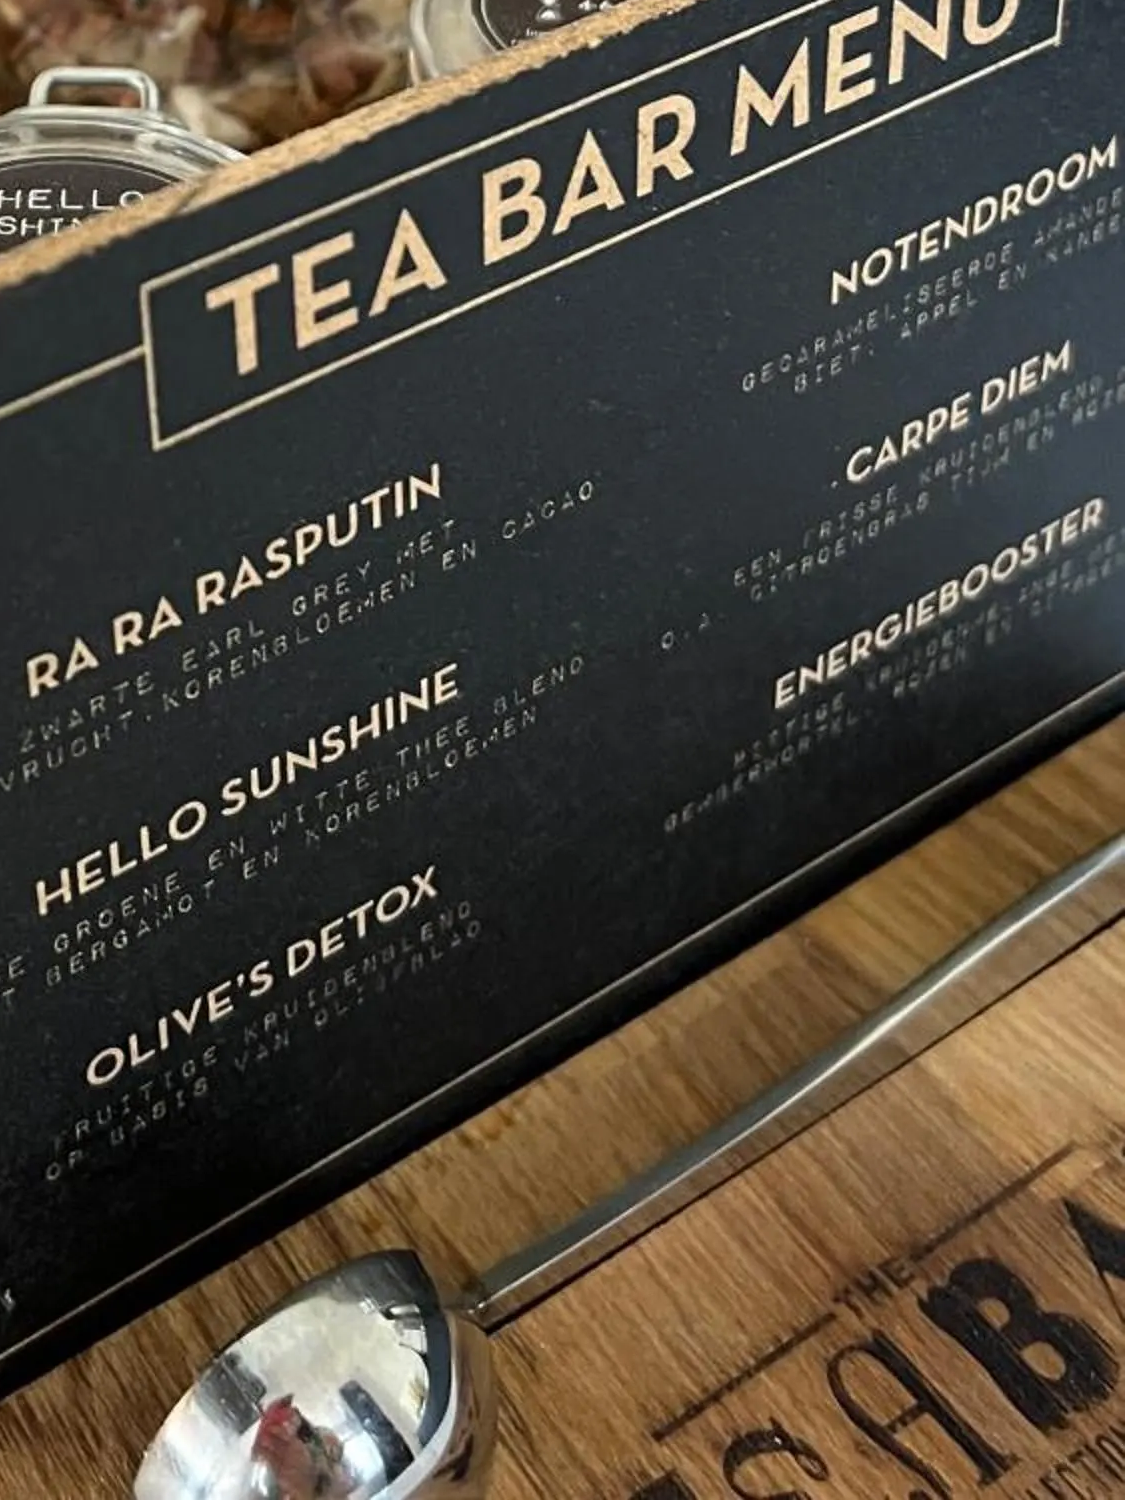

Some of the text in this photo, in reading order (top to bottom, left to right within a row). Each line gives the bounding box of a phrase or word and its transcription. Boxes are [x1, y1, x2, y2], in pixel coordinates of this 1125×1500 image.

[206, 209, 448, 377] TEA
[482, 97, 693, 267] BAR
[830, 134, 1118, 305] NOTENDROOM
[900, 291, 977, 339] APPEL
[998, 262, 1026, 291] EN
[846, 339, 1072, 484] CARPE DIEM
[20, 518, 457, 754] ZWARTE EARL GREY MET
[26, 463, 442, 699] RA RA RASPUTIN
[163, 570, 417, 712] KORENBLOEMEN
[442, 538, 477, 571] EN
[502, 480, 595, 540] CACAO
[733, 547, 783, 588] EEN
[774, 496, 1107, 709] ENERGIEBOOSTER
[35, 662, 460, 916] HELLO SUNSHINE
[46, 879, 216, 987] BERGAMOT
[242, 844, 280, 880] EN
[306, 705, 539, 847] KORENBLOEMEN
[54, 871, 182, 954] GROENE
[208, 836, 246, 872] EN
[270, 768, 373, 835] WITTE
[395, 715, 471, 768] THEE
[493, 656, 586, 716] BLEND
[86, 865, 438, 1087] OLIVE'S DETOX
[45, 1148, 85, 1182] OP
